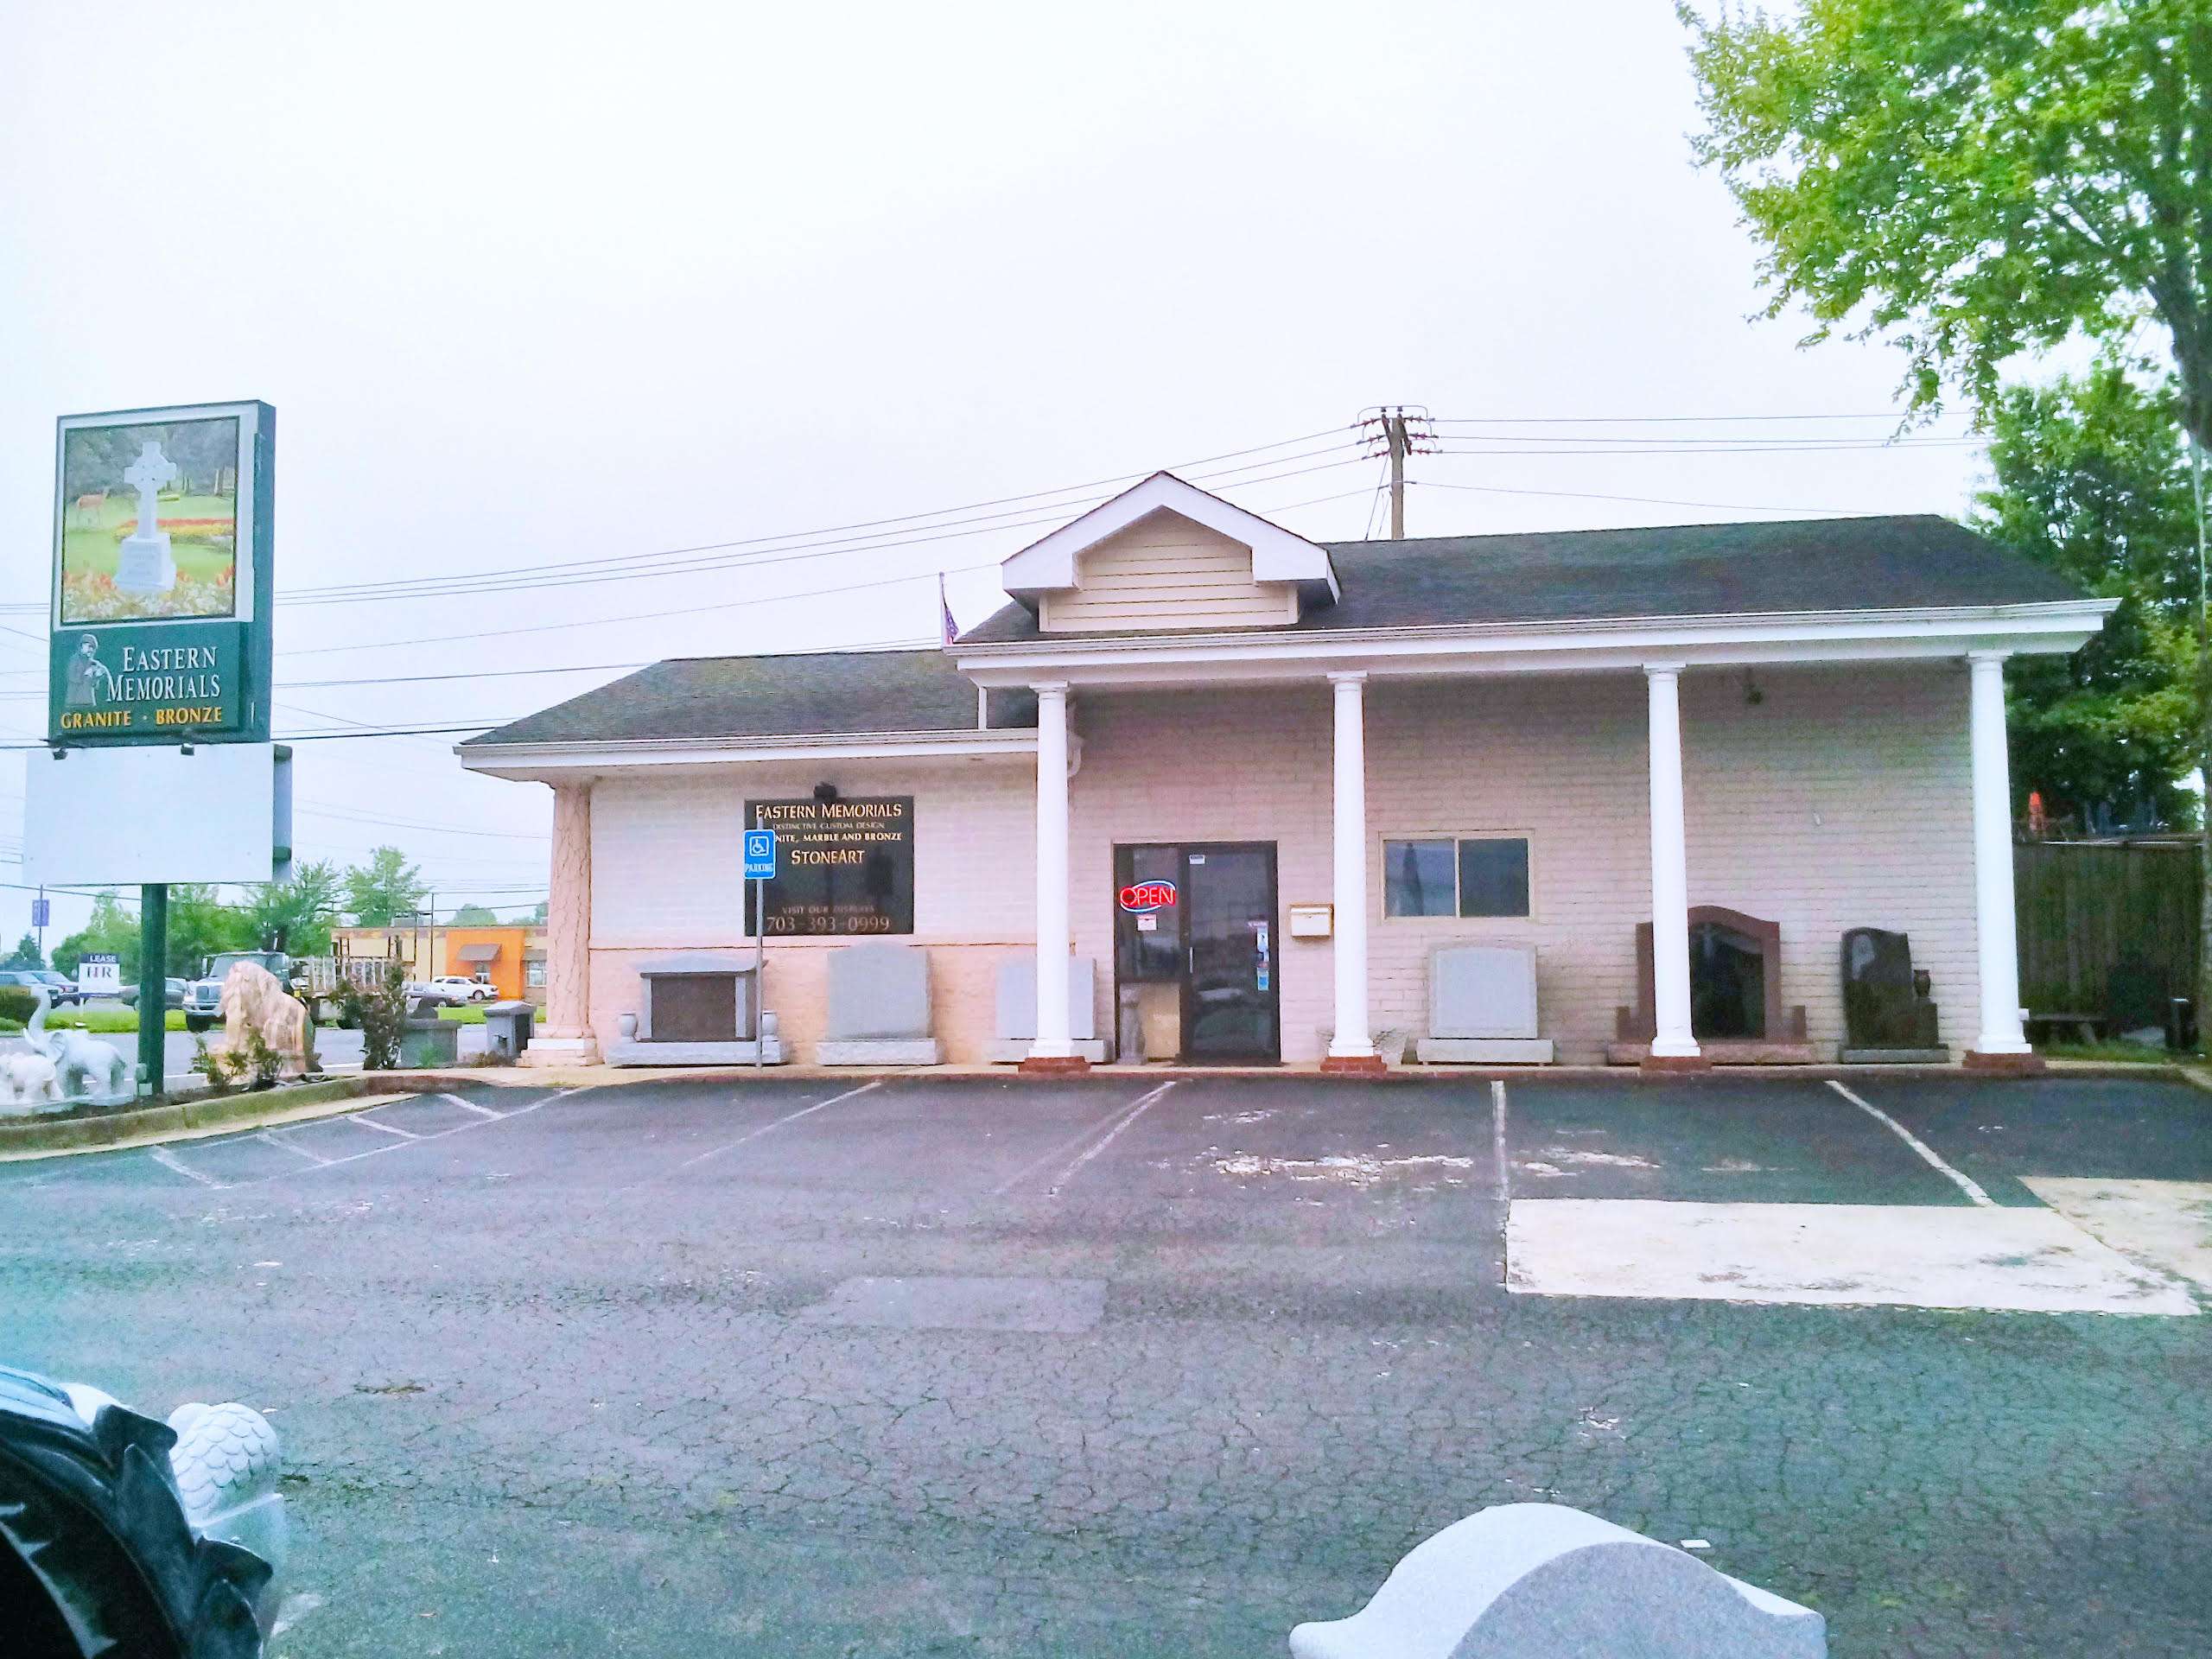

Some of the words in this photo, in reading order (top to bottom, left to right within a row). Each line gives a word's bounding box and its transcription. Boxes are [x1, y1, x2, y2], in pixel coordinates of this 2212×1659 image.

[123, 646, 218, 672] EASTERN
[106, 674, 221, 702] MEMORIALS
[60, 710, 131, 729] GRANITE
[155, 706, 222, 726] BRONZE
[756, 804, 816, 819] EASTERN
[821, 803, 902, 818] MEMORIALS
[775, 834, 800, 843] NITE,
[802, 833, 839, 842] MARBLE
[842, 832, 862, 842] AND
[864, 832, 902, 842] BRONZE
[745, 863, 774, 873] PARKING
[1120, 887, 1175, 906] OPEN
[781, 906, 804, 914] VISIT
[808, 905, 830, 914] OUR
[766, 916, 890, 932] 703-393-0999
